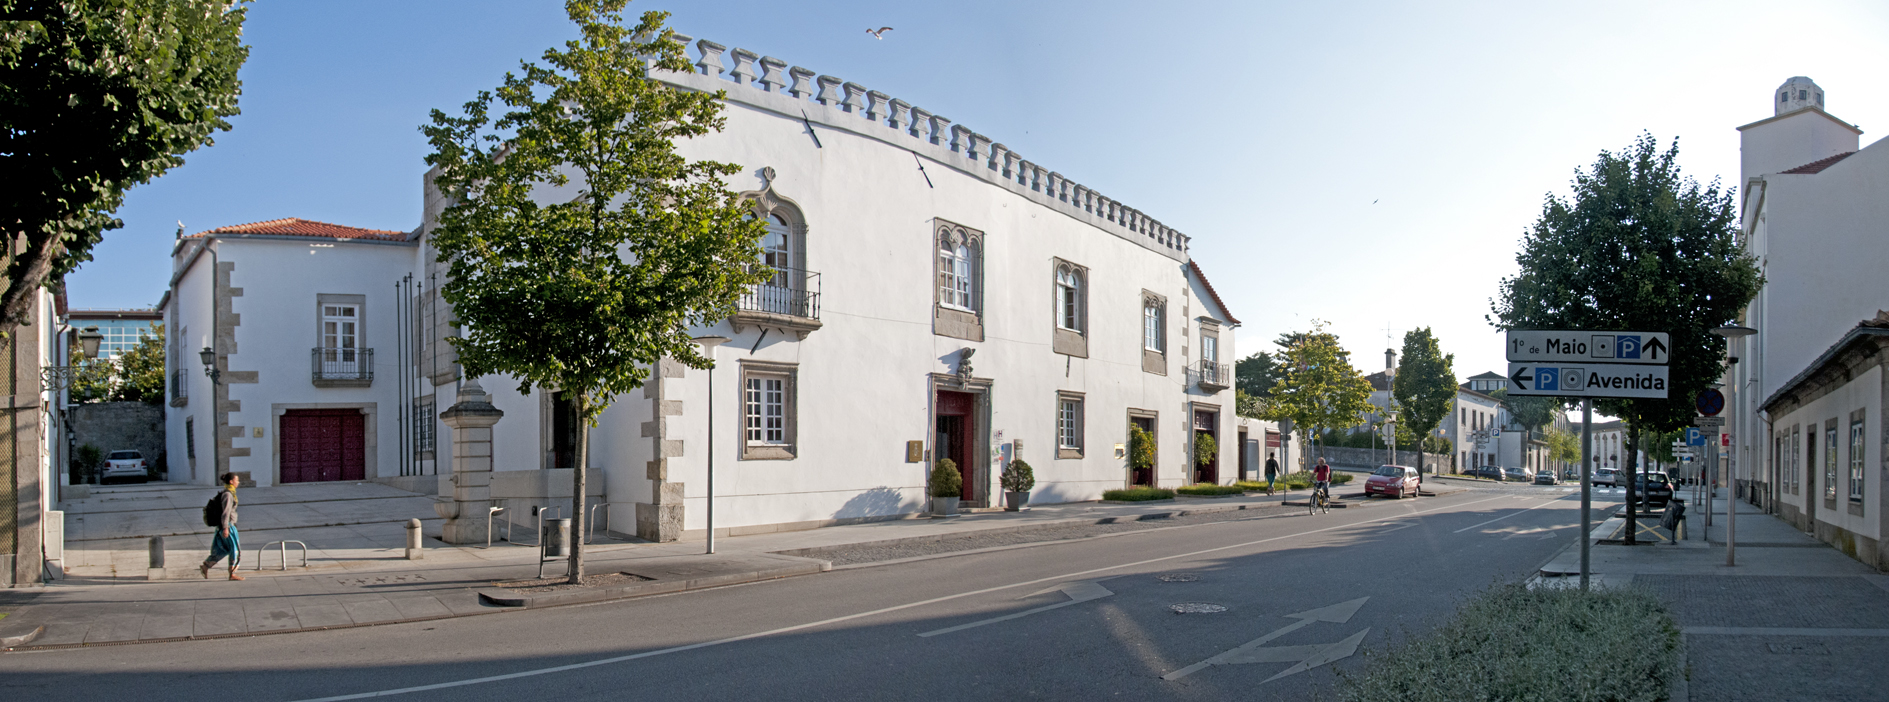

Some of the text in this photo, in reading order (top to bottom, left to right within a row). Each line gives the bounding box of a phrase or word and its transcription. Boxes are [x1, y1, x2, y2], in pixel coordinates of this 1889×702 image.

[1529, 345, 1540, 354] de
[1546, 338, 1587, 355] Maio
[1622, 341, 1635, 358] P
[1540, 372, 1665, 391] P Avenida
[1690, 429, 1700, 444] P
